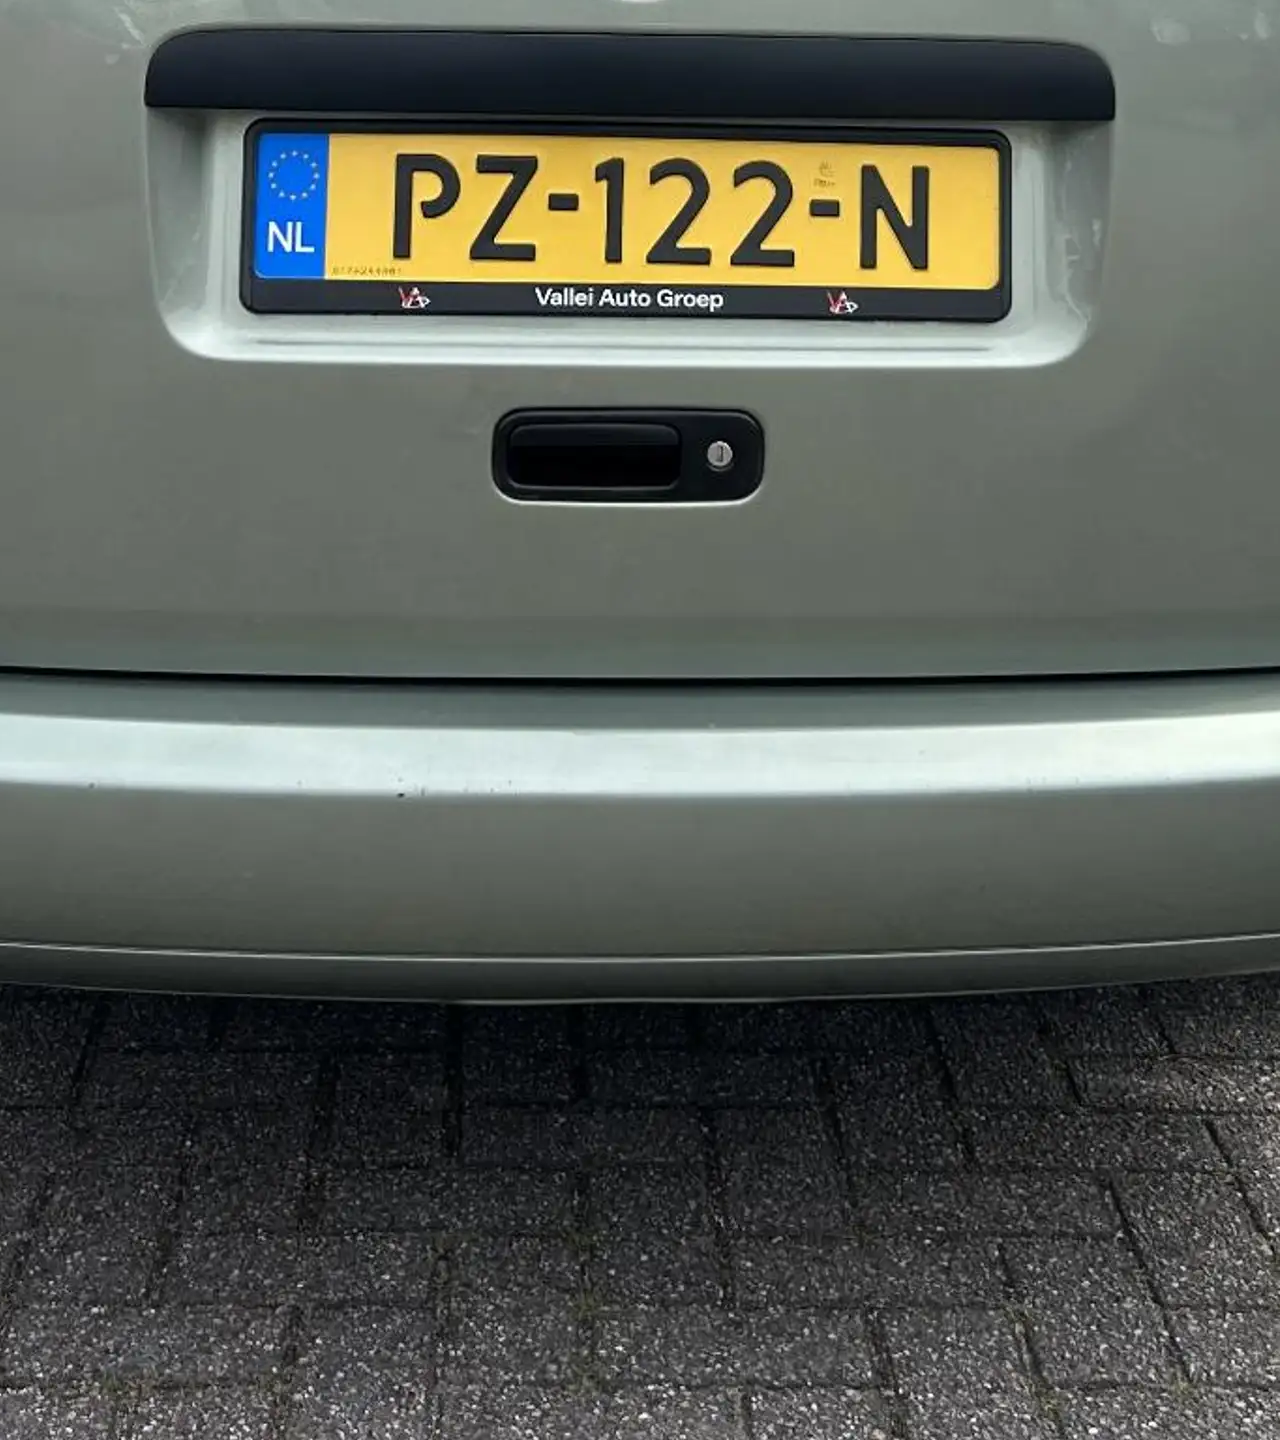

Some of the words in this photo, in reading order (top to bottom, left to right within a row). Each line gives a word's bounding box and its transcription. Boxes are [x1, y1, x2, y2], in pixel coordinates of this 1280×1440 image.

[392, 153, 931, 271] PZ-122-N
[266, 221, 315, 253] NL
[534, 286, 595, 307] Vallei
[598, 288, 652, 308] Auto
[656, 289, 724, 311] Groep
